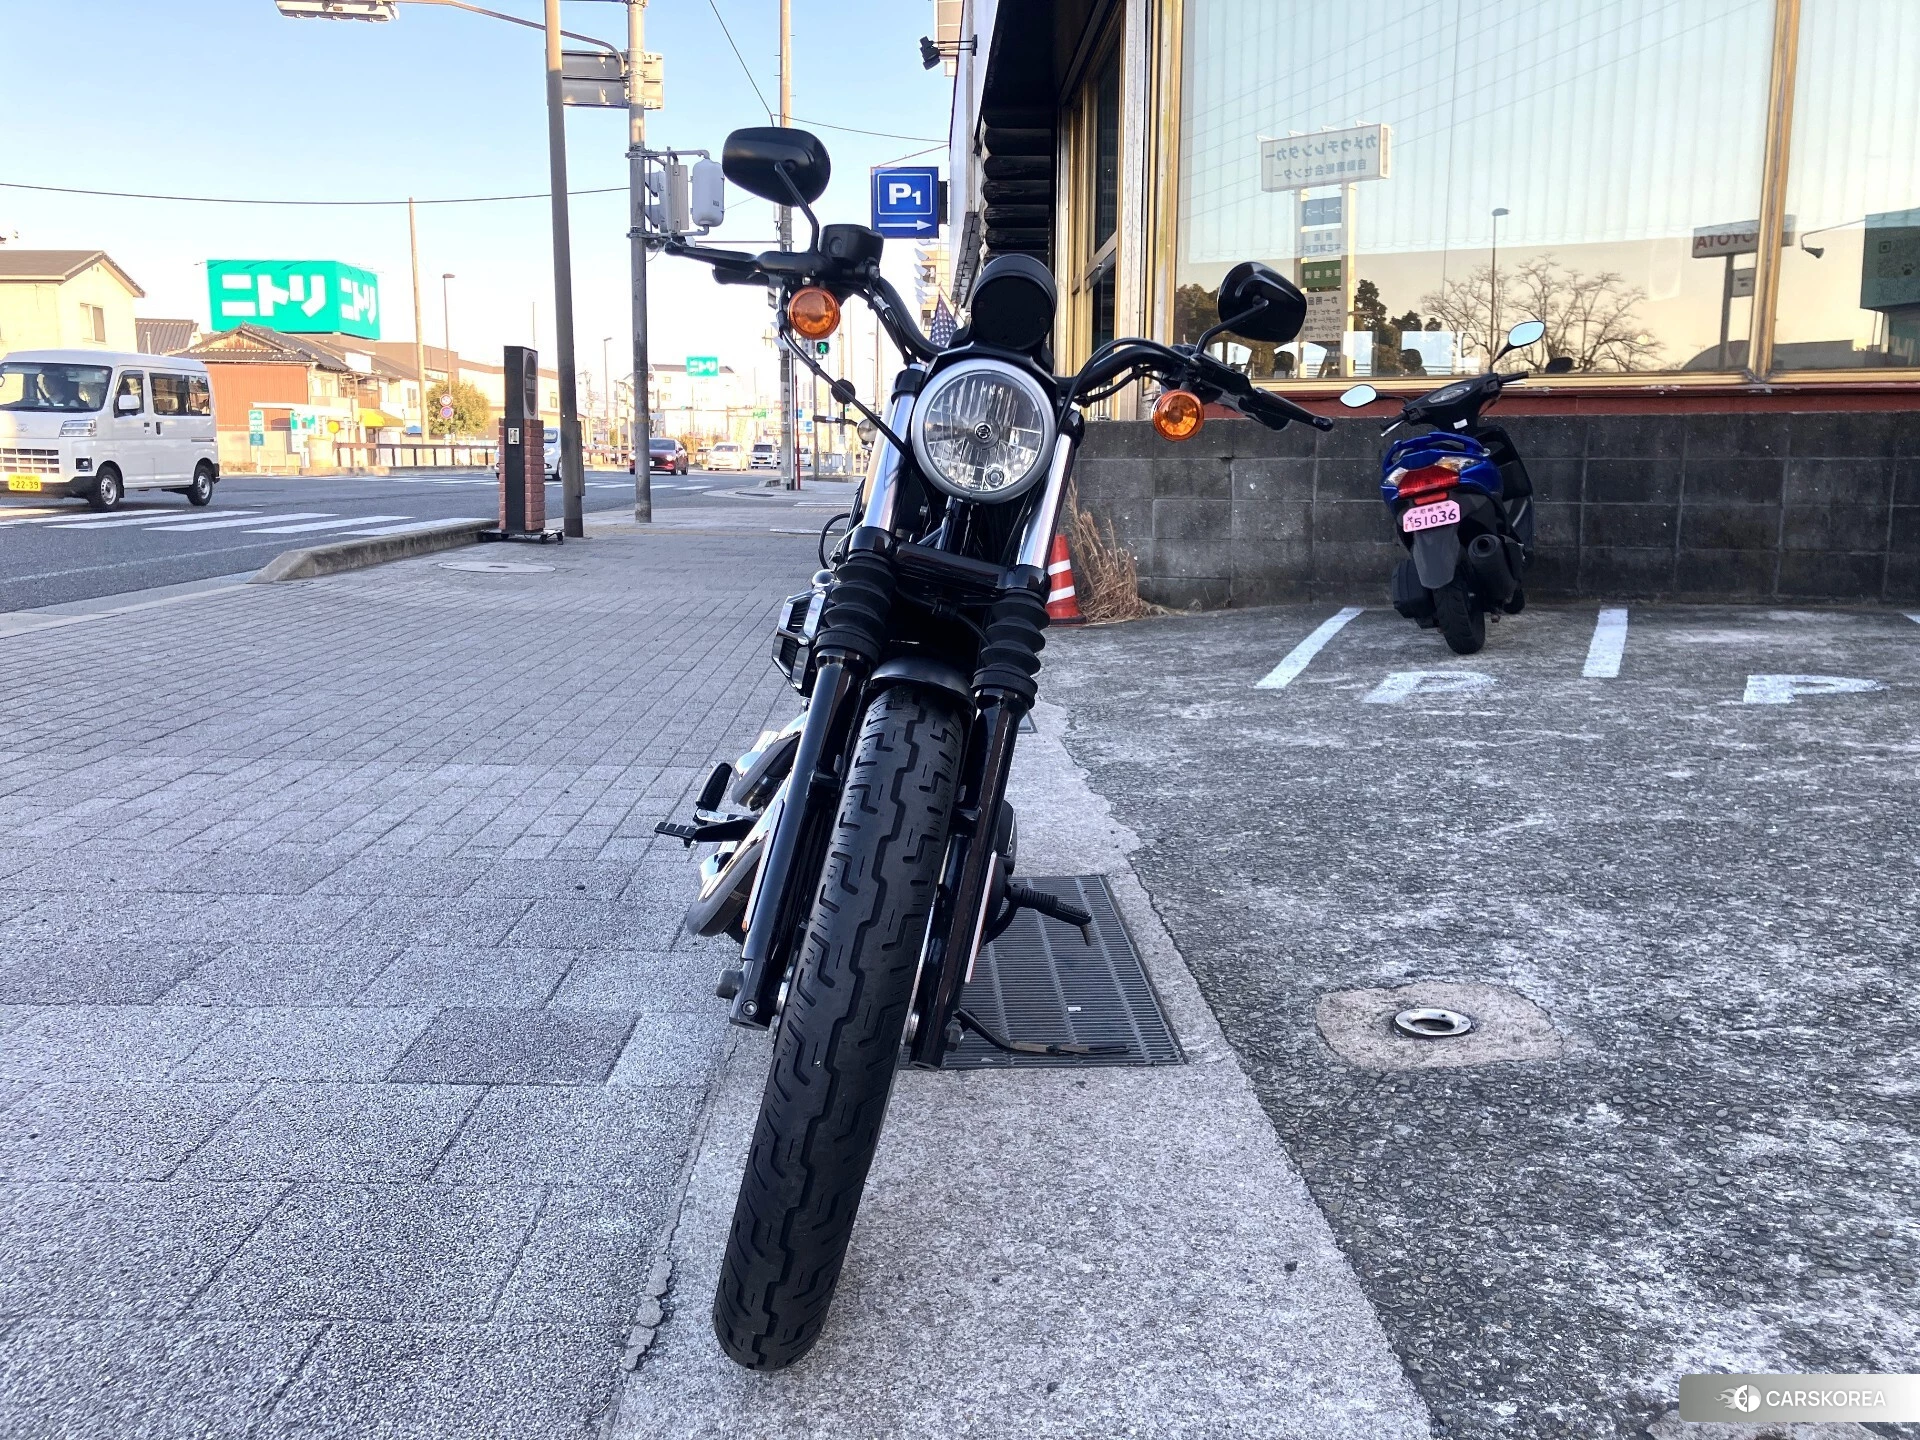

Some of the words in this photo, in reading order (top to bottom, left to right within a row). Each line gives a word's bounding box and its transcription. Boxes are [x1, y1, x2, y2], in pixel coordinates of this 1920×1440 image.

[888, 182, 921, 205] P1
[222, 274, 326, 317] ニトリ
[340, 277, 376, 325] ニトリ
[1414, 508, 1457, 527] 51036
